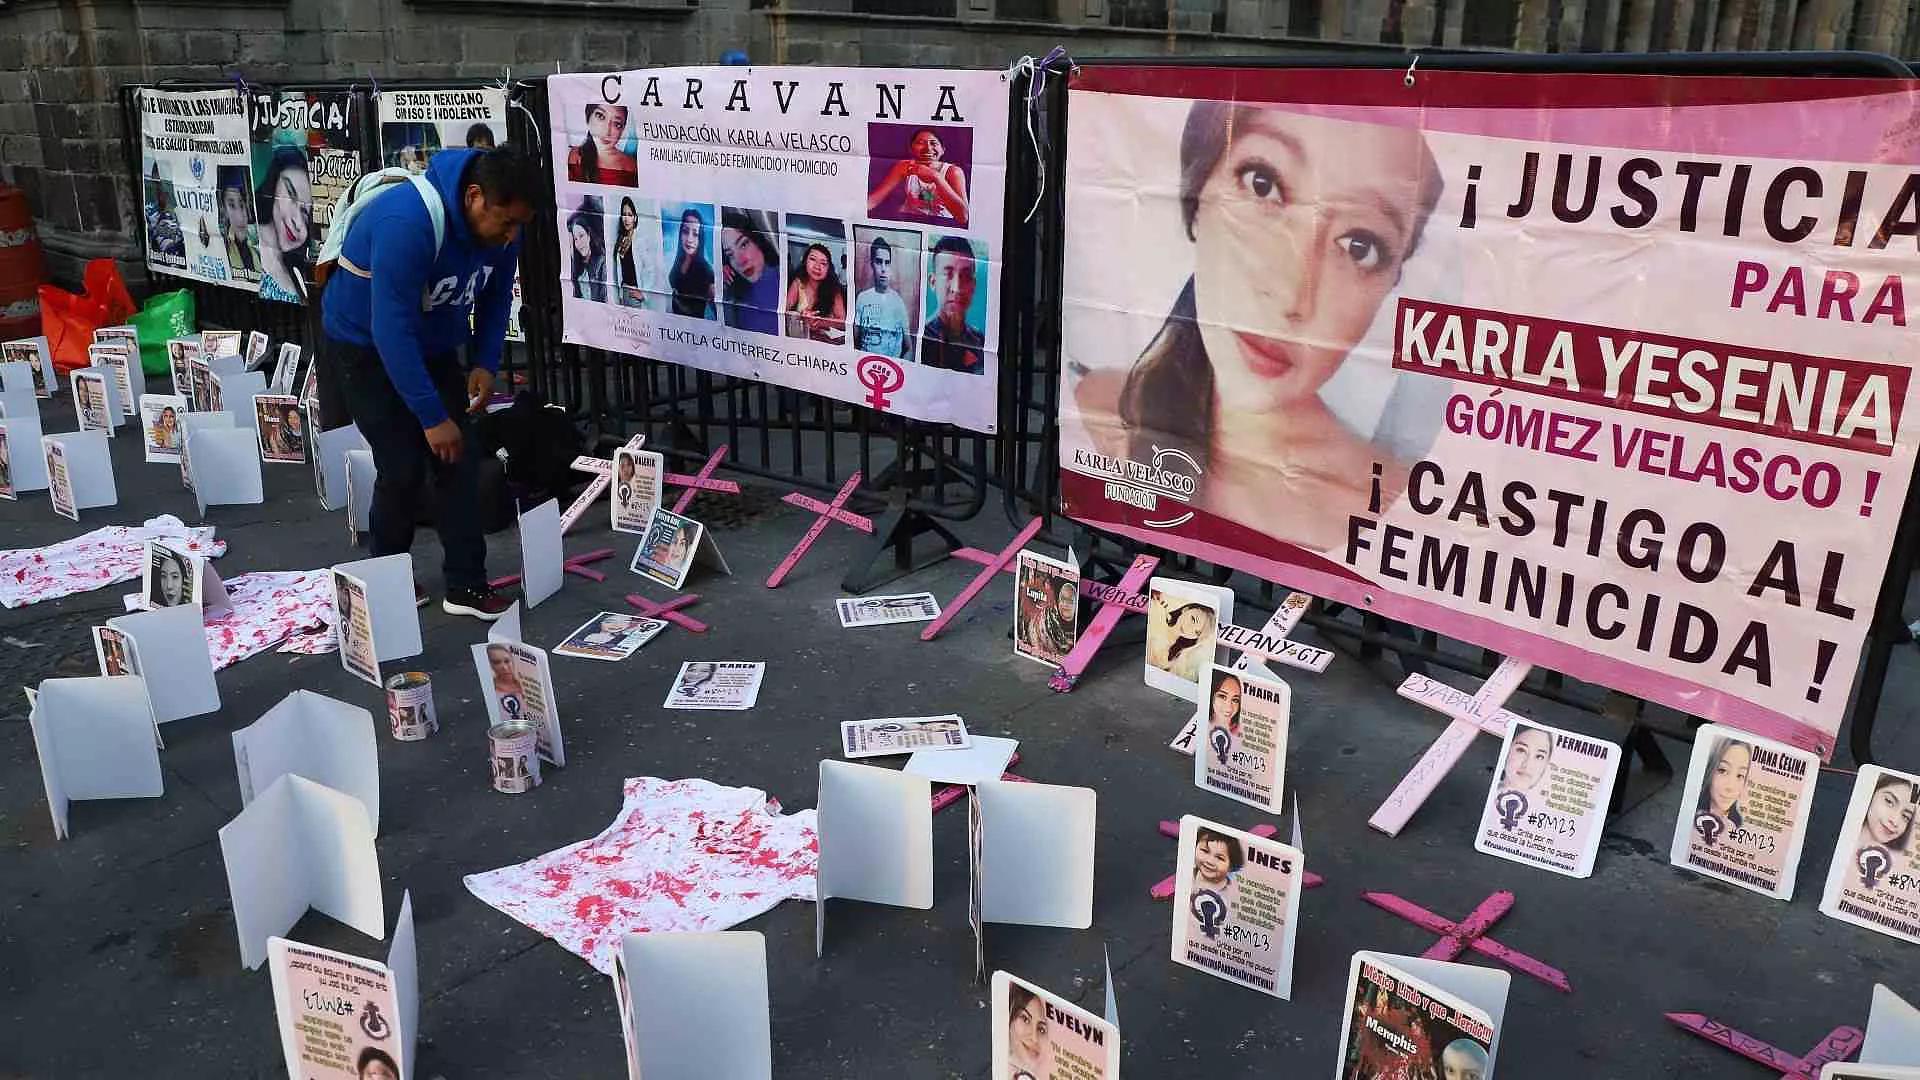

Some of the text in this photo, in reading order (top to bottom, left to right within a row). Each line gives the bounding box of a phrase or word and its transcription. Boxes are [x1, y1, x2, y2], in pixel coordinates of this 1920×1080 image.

[395, 94, 431, 106] ESTADO
[427, 107, 432, 119] E
[600, 74, 964, 122] CARAVANA
[643, 122, 851, 153] FUNDACIÓN KARLA VELASCO
[650, 147, 683, 164] FAMILIAS
[720, 153, 731, 167] DE
[732, 154, 783, 172] FEMINICIDIO
[782, 158, 790, 171] Y
[790, 159, 838, 177] HOMICIDIO
[1506, 152, 1920, 250] JUSTICIA
[1729, 261, 1907, 327] PARA
[658, 327, 708, 346] TUXTLA
[786, 353, 849, 377] CHIAPAS
[1400, 307, 1895, 446] KARLA YESENIA
[1445, 387, 1602, 463] GÓMEZ
[1611, 423, 1842, 509] VELASCO
[1074, 448, 1195, 494] KARLA VELASCO
[1105, 482, 1157, 511] FUNDACIÓN
[1407, 459, 1727, 584] CASTIGO
[1746, 539, 1856, 621] AL
[1345, 515, 1774, 688] FEMINICIDA
[1242, 682, 1280, 705] THAIRA
[1231, 751, 1266, 773] #8M23
[1556, 734, 1609, 761] FERNANDA
[1752, 745, 1807, 777] DIANA CELINA
[1527, 812, 1576, 838] #8M23
[1728, 828, 1776, 854] #8M23
[1247, 846, 1292, 875] INES
[1223, 922, 1270, 952] #8M23
[1044, 1001, 1104, 1047] EVELYN
[1365, 1015, 1418, 1055] Memphis
